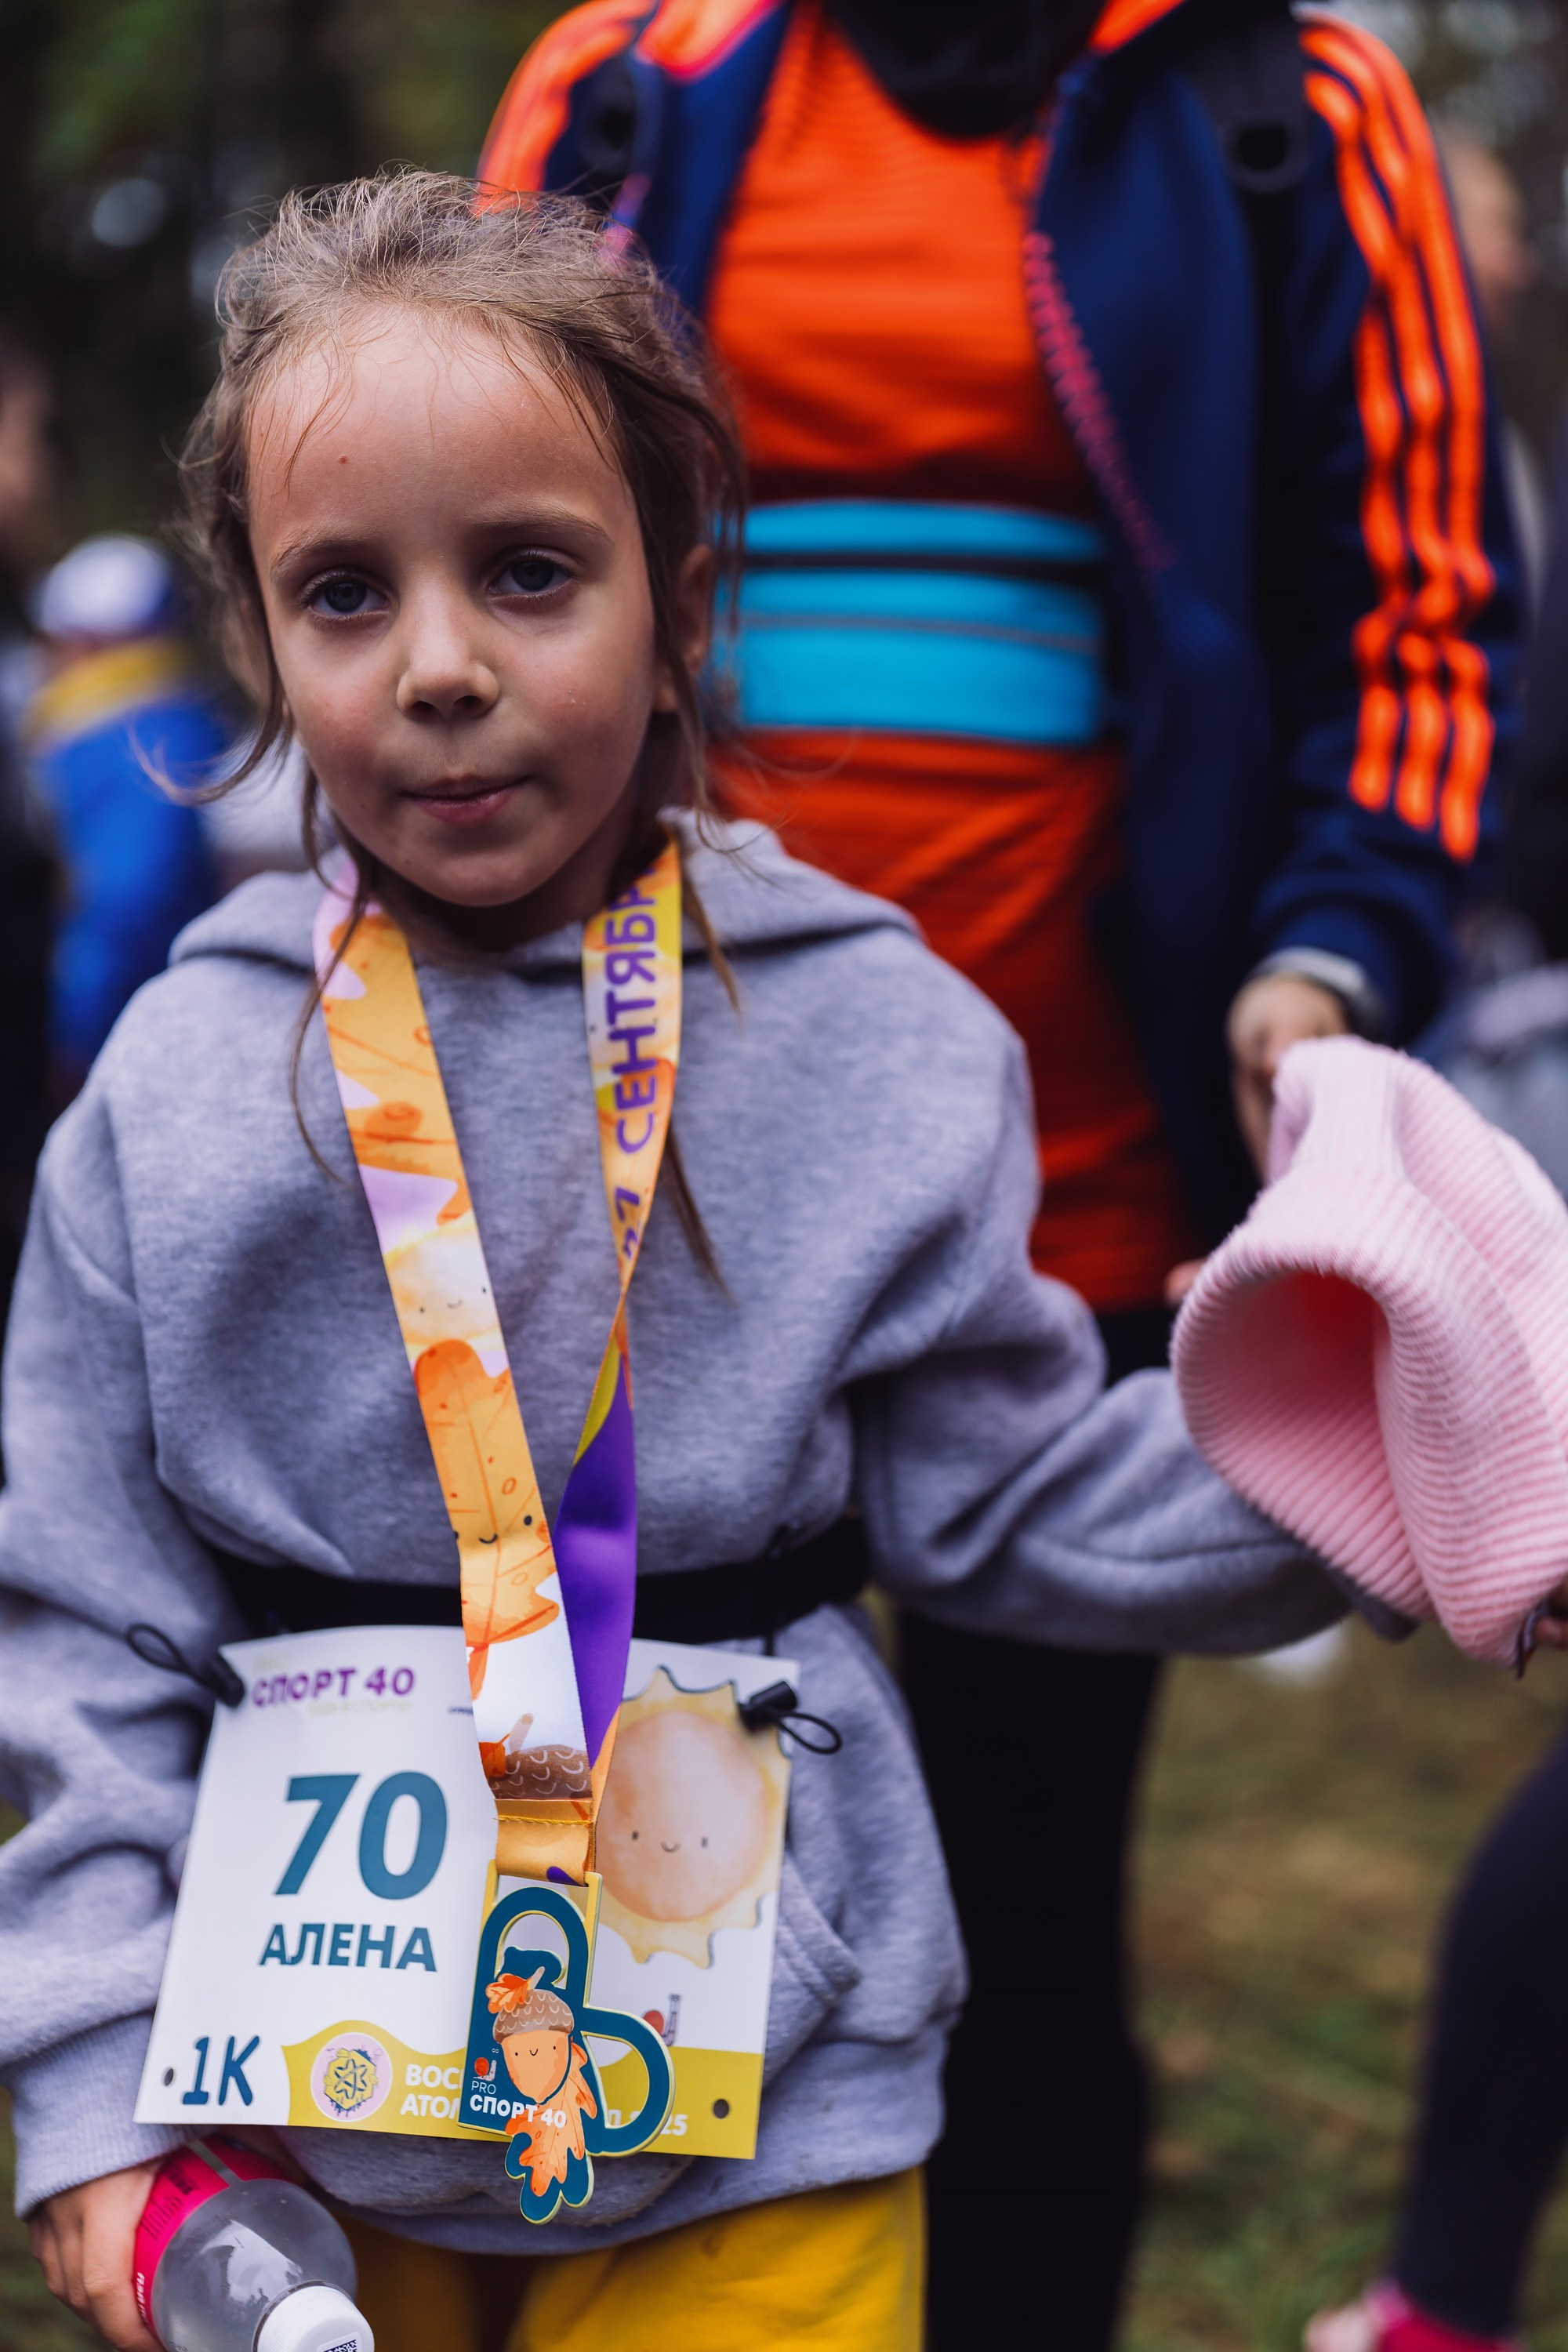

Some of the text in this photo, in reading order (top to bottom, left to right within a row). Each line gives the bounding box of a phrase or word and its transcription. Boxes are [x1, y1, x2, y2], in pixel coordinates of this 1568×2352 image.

[252, 1667, 357, 1708] СПОРТ
[365, 1667, 415, 1697] 40
[274, 1770, 448, 1900] 70
[258, 1923, 437, 1973] АЛЕНА
[405, 2063, 462, 2090] ВОС
[471, 2080, 497, 2096] PRO
[470, 2094, 567, 2129] СПОРТ 40
